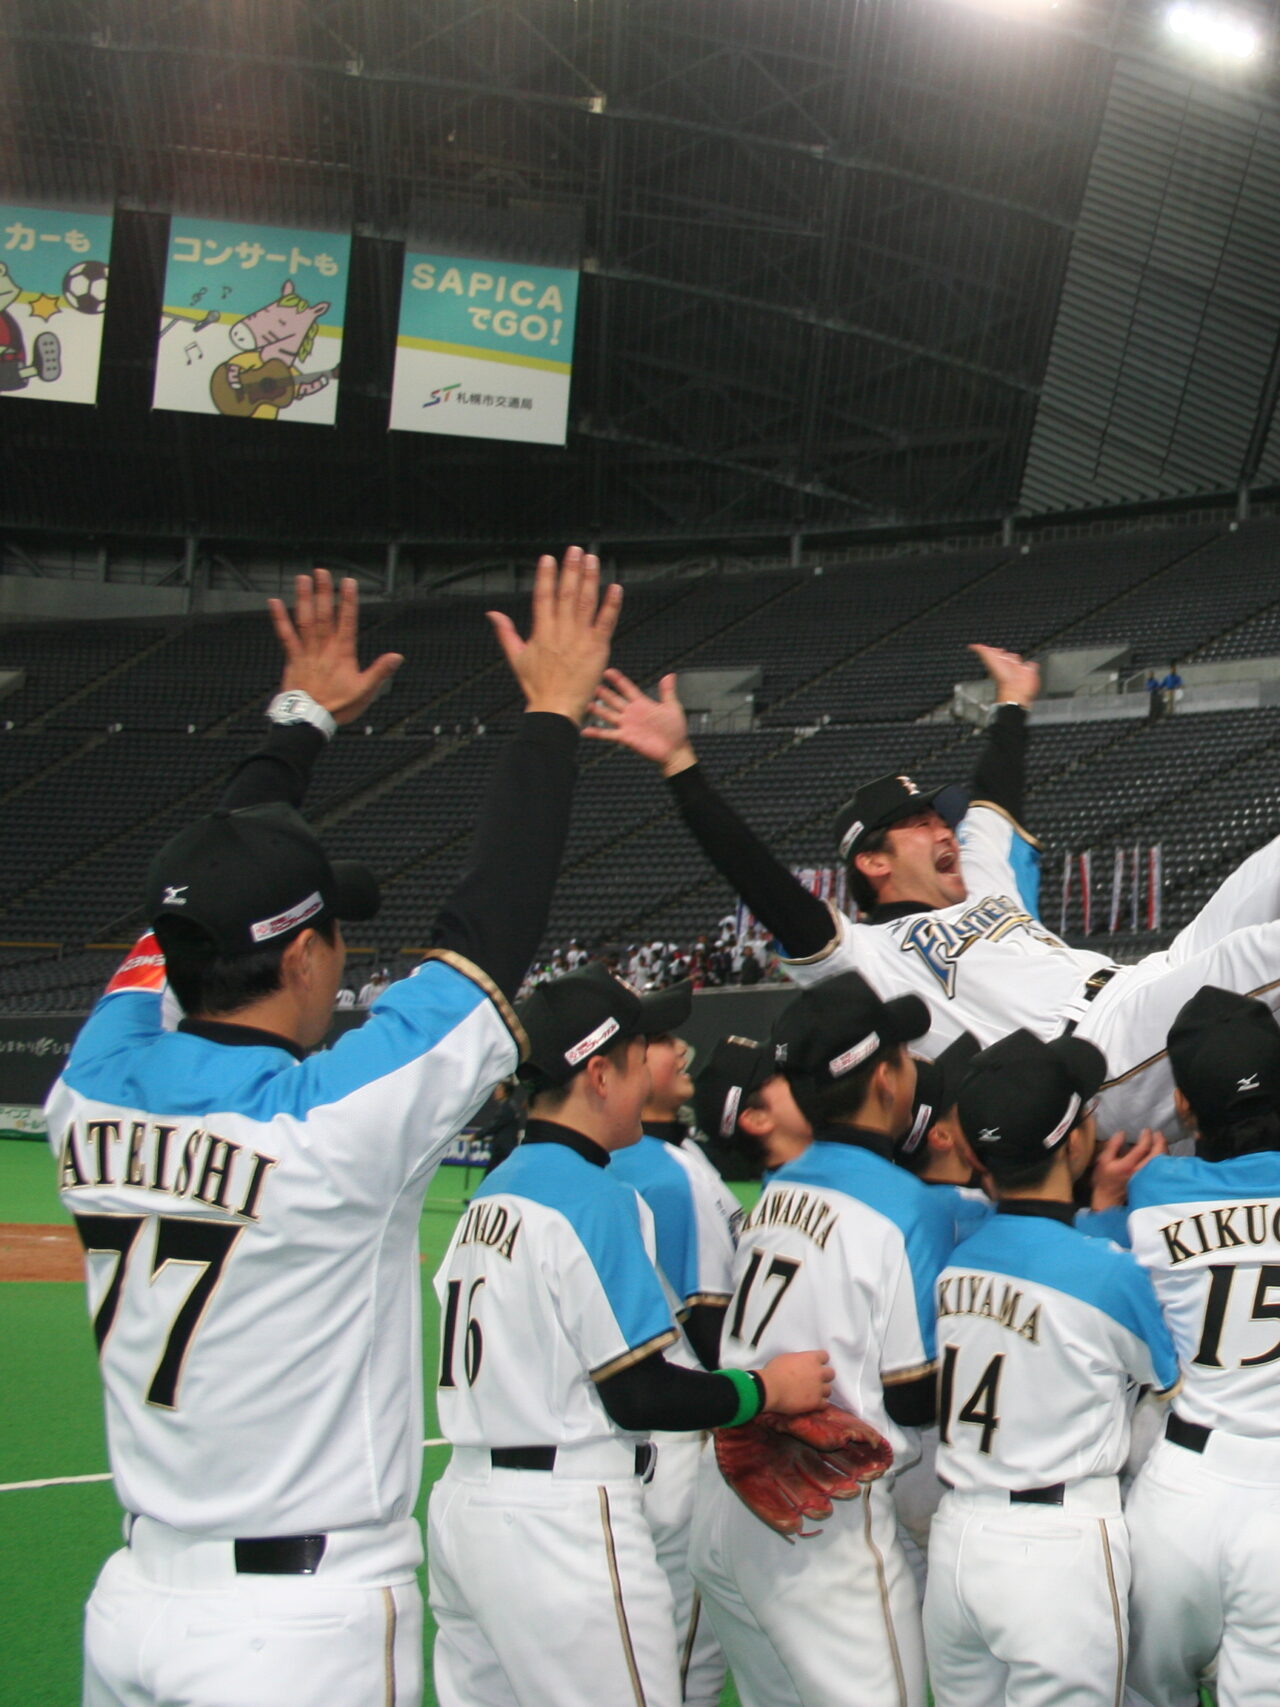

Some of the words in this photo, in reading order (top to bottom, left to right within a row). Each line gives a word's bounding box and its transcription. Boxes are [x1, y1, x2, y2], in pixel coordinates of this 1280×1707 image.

[173, 236, 339, 277] コンサートも
[411, 263, 564, 313] SAPICA
[468, 306, 561, 346] でGO!
[71, 1211, 247, 1411] 77
[438, 1276, 486, 1391] 16
[730, 1246, 802, 1350] 17
[937, 1342, 1006, 1456] 14
